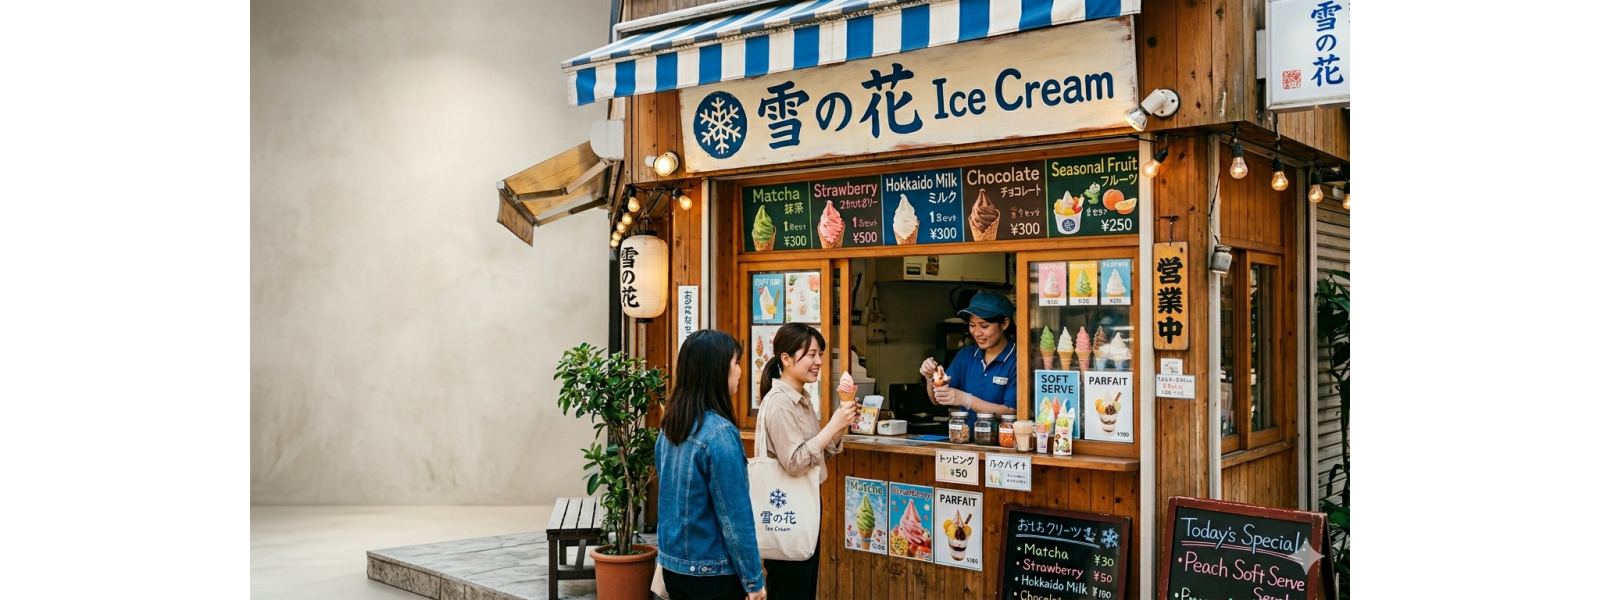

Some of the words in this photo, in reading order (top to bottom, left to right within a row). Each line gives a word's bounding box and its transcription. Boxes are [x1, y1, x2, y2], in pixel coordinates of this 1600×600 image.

[1310, 1, 1344, 87] 雪の花
[757, 63, 923, 149] 雪の花
[932, 78, 986, 119] Ice
[995, 68, 1114, 111] Cream
[1051, 157, 1104, 177] Seasonal
[1107, 155, 1138, 172] Fruit
[886, 175, 933, 192] Hokkaido
[935, 172, 958, 188] Milk
[966, 167, 1040, 186] Chocolate
[1100, 173, 1138, 187] フルーツ
[752, 186, 800, 203] Matcha
[814, 181, 878, 198] Strawberry
[928, 190, 957, 204] ミルク
[1000, 183, 1042, 198] チョコレート
[1010, 222, 1040, 236] ¥300
[1101, 217, 1132, 232] ¥250
[783, 235, 807, 247] ¥300
[853, 231, 878, 244] ¥500
[930, 227, 957, 240] ¥300
[620, 246, 641, 308] 雪の花
[1157, 256, 1184, 344] 営業中
[1041, 374, 1069, 384] SOFT
[1088, 376, 1129, 386] PARFAIT
[1041, 384, 1075, 394] SERVE
[939, 494, 978, 508] PARFAIT
[760, 510, 797, 525] 雪の花
[1181, 517, 1236, 549] Today's
[1024, 543, 1069, 560] Matcha
[1094, 554, 1115, 567] ¥30
[1022, 558, 1084, 580] Strawberry
[1093, 570, 1113, 583] ¥50
[1184, 551, 1228, 578] Peach
[1232, 559, 1266, 584] Soft
[1267, 565, 1305, 592] Serve
[1021, 574, 1064, 591] Hokkaido
[1066, 580, 1088, 596] Milk
